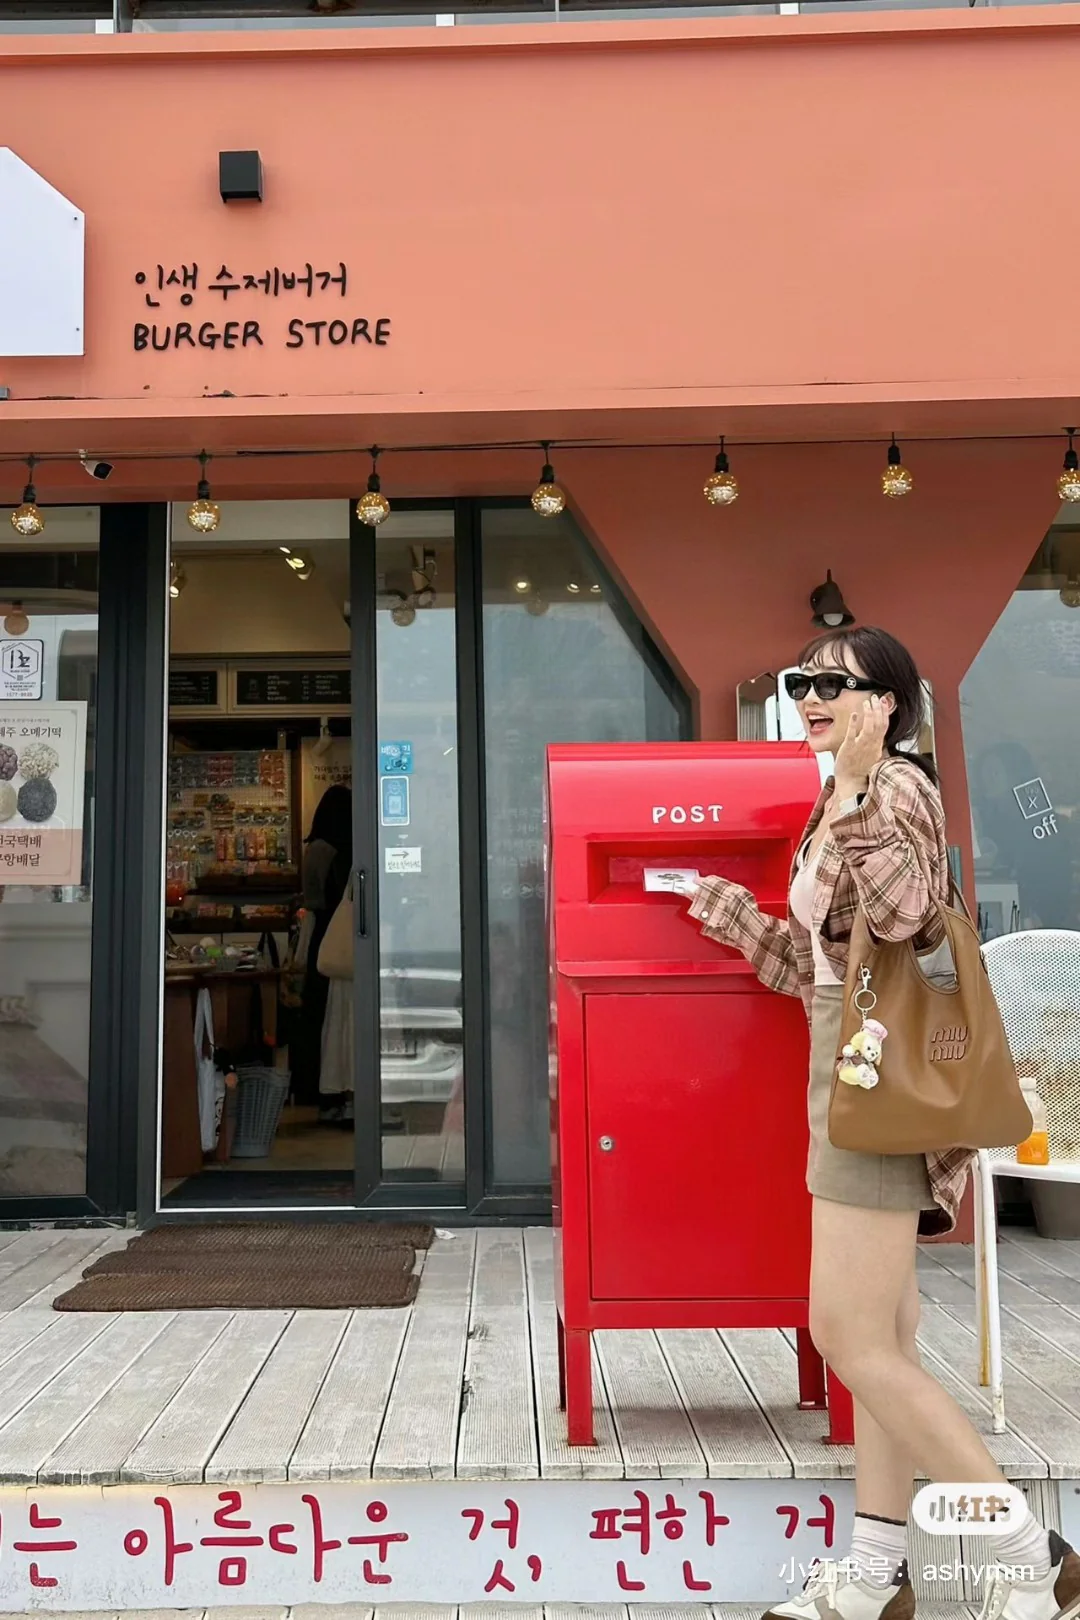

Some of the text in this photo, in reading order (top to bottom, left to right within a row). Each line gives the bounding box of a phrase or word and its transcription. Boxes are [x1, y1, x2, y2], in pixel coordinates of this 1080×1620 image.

[135, 262, 347, 307] 인생 수제버거
[134, 318, 391, 351] BURGER STORE
[19, 726, 62, 738] 오메기떡
[652, 804, 723, 824] POST
[1032, 813, 1058, 839] off
[0, 853, 40, 867] 항배달
[0, 1502, 78, 1588] 는
[124, 1490, 409, 1586] 아름다운
[589, 1490, 730, 1591] 편한
